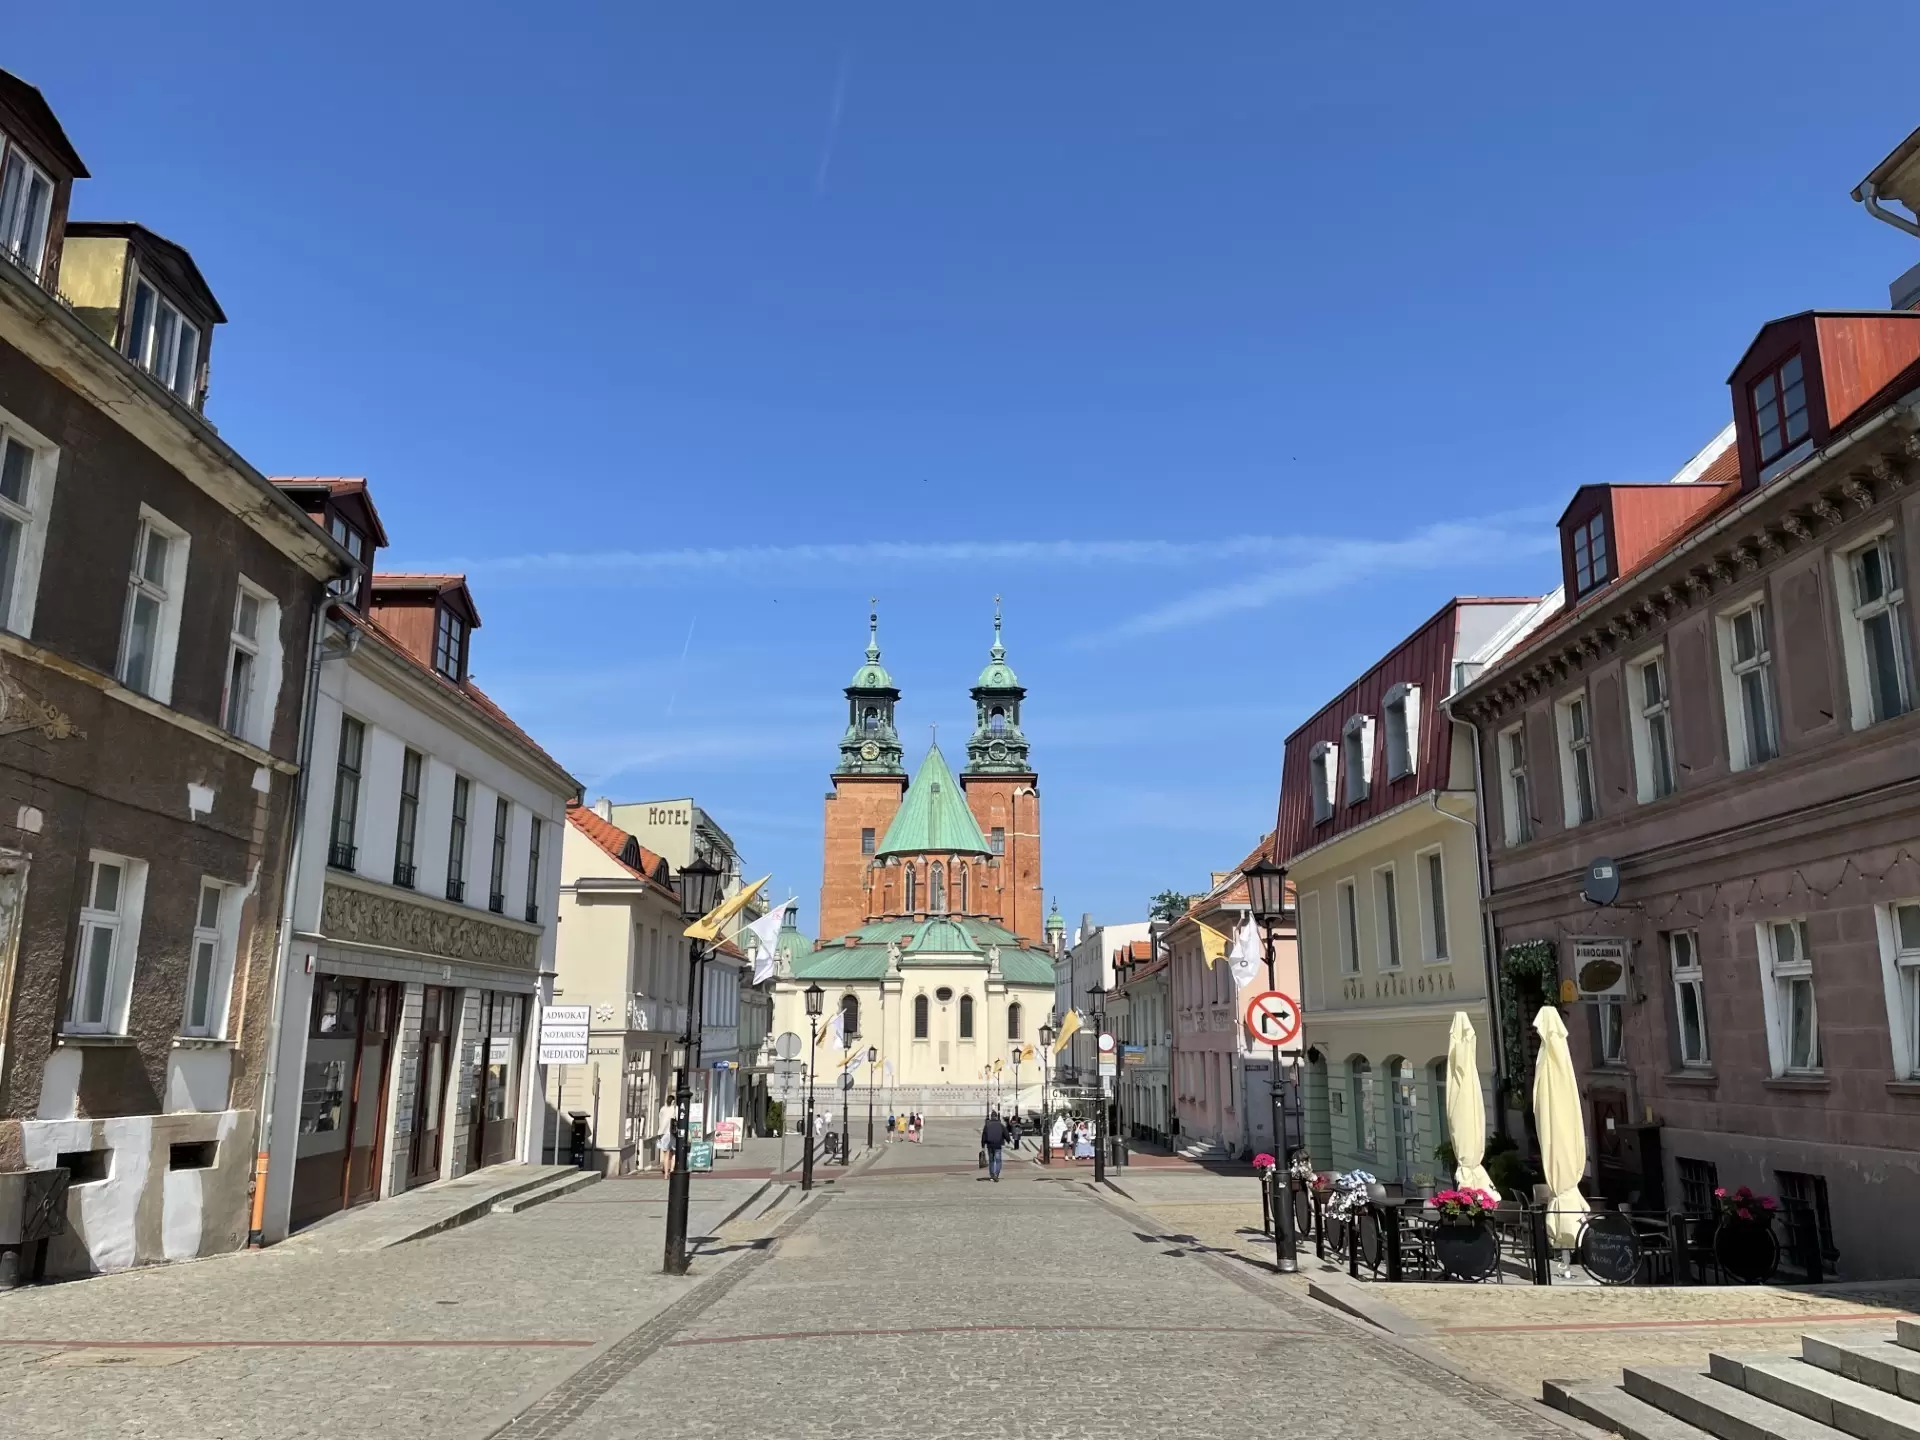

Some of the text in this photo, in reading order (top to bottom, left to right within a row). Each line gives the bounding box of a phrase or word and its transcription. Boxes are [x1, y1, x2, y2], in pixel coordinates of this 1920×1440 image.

[649, 807, 689, 825] HOTEL
[1576, 948, 1622, 957] PIEROGARNIA
[545, 1011, 587, 1020] ADWOKAT
[544, 1031, 586, 1039] NOTARIUSZ
[542, 1049, 585, 1059] MEDIATOR
